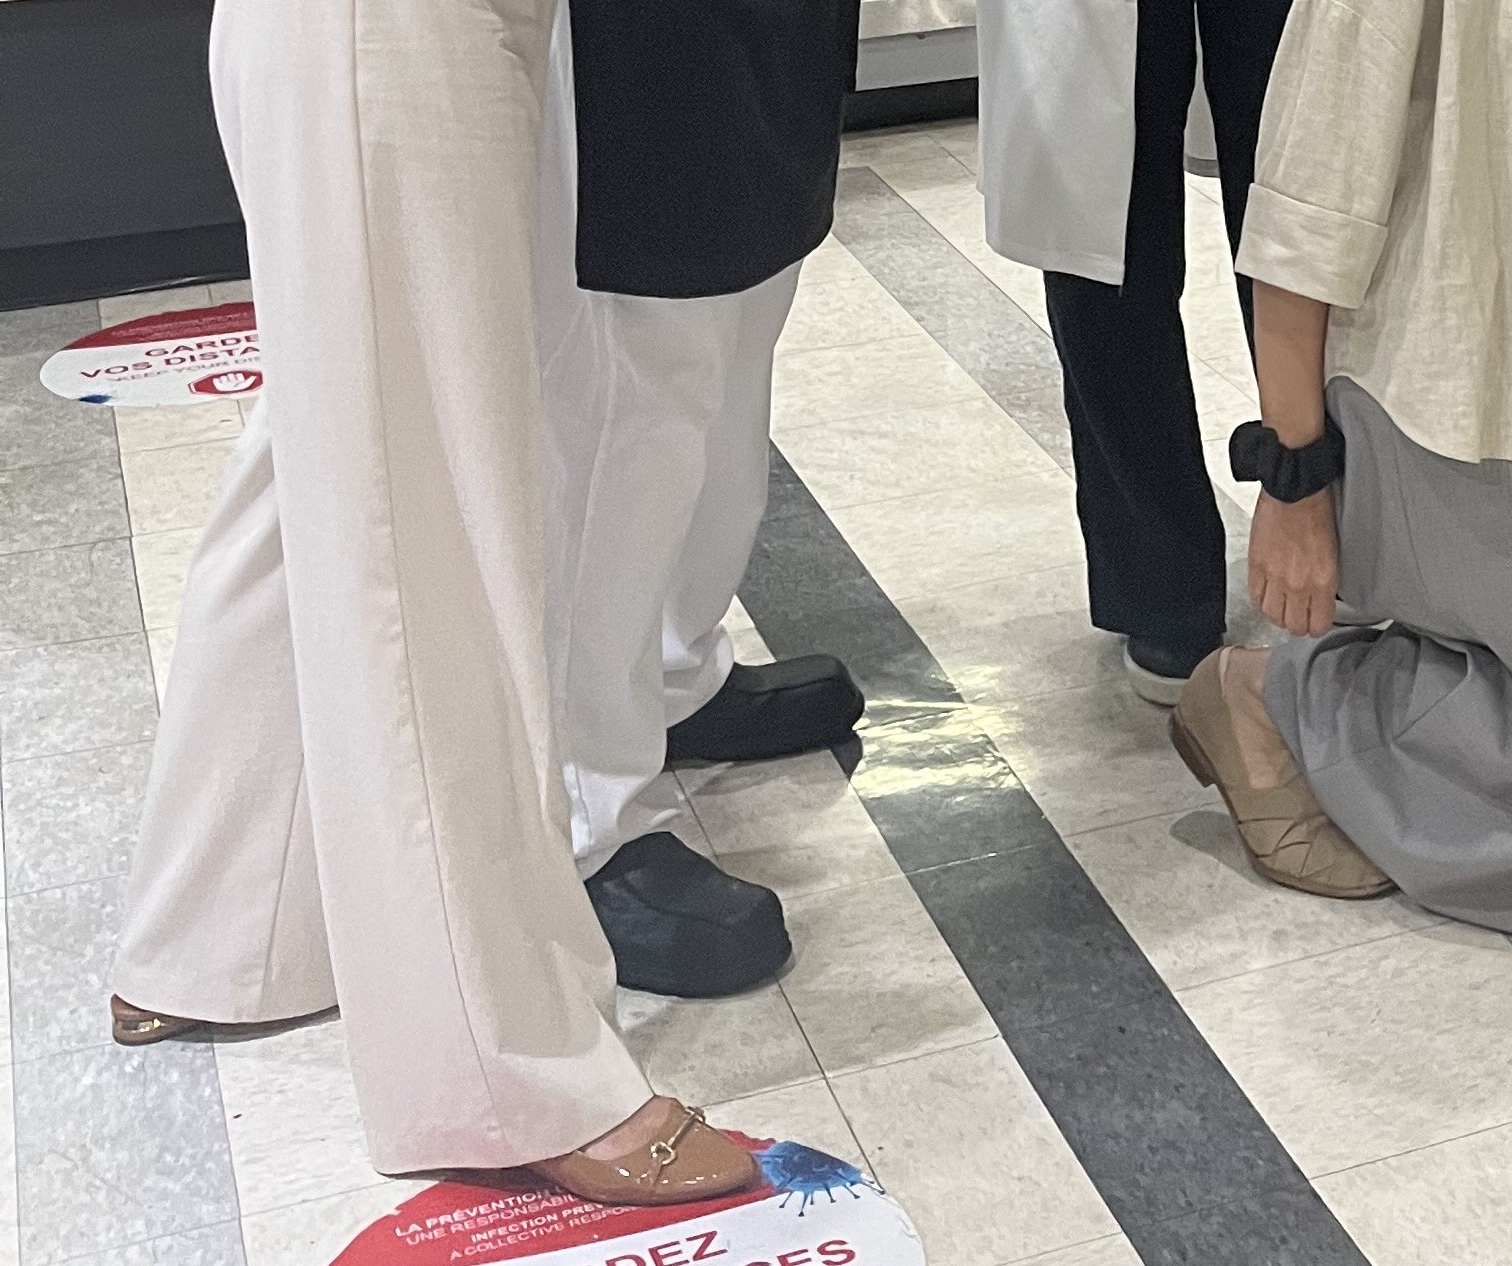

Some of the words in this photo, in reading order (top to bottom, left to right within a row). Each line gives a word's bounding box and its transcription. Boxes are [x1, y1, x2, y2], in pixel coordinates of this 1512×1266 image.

[145, 334, 258, 356] GARDE
[80, 362, 152, 378] VOS
[164, 346, 260, 366] DISTA
[395, 1221, 423, 1237] LA
[406, 1228, 447, 1246] UNE
[450, 1194, 579, 1234] RESPONSABIL
[471, 1212, 558, 1243] INFECTION
[450, 1249, 464, 1260] A
[464, 1221, 565, 1256] COLLECTIVE
